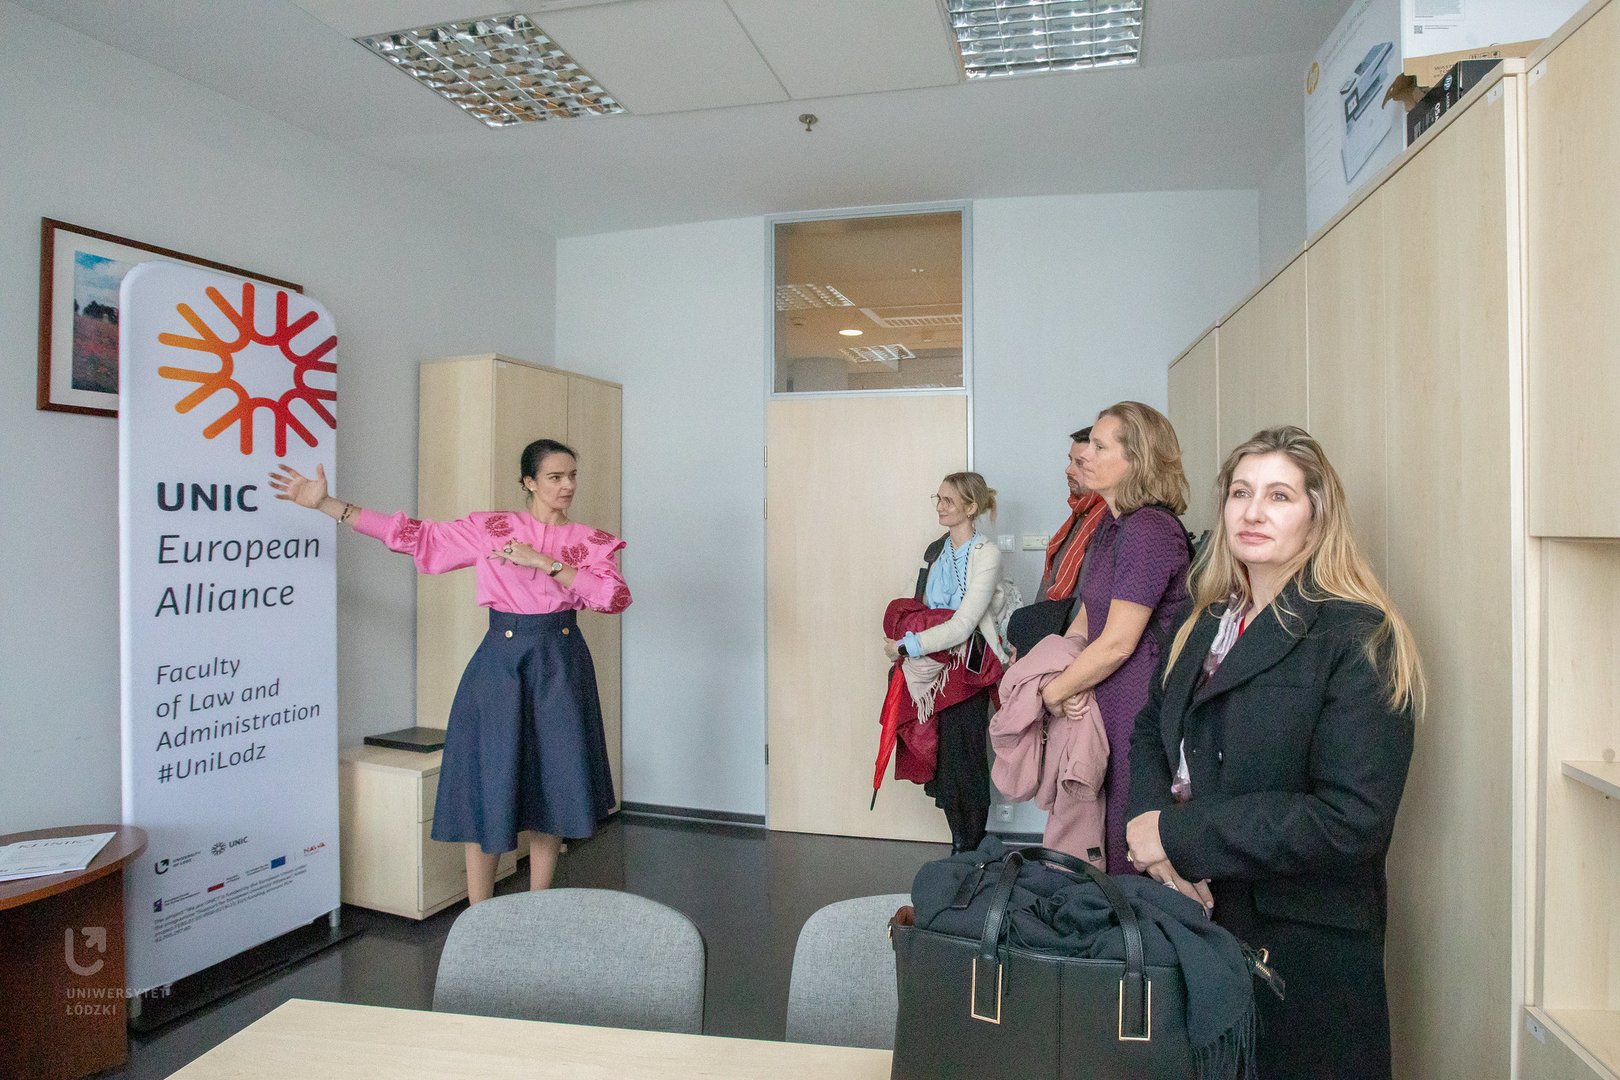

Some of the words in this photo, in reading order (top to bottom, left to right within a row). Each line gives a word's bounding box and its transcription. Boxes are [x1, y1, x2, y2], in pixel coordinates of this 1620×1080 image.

[156, 481, 258, 512] UNIC
[157, 534, 320, 567] European
[155, 583, 295, 617] Alliance
[156, 656, 240, 685] Faculty
[156, 693, 183, 720] of
[189, 690, 234, 712] Law
[241, 678, 280, 702] and
[155, 703, 320, 752] Administration
[158, 743, 266, 784] #UniLodz
[229, 836, 248, 848] UNIC
